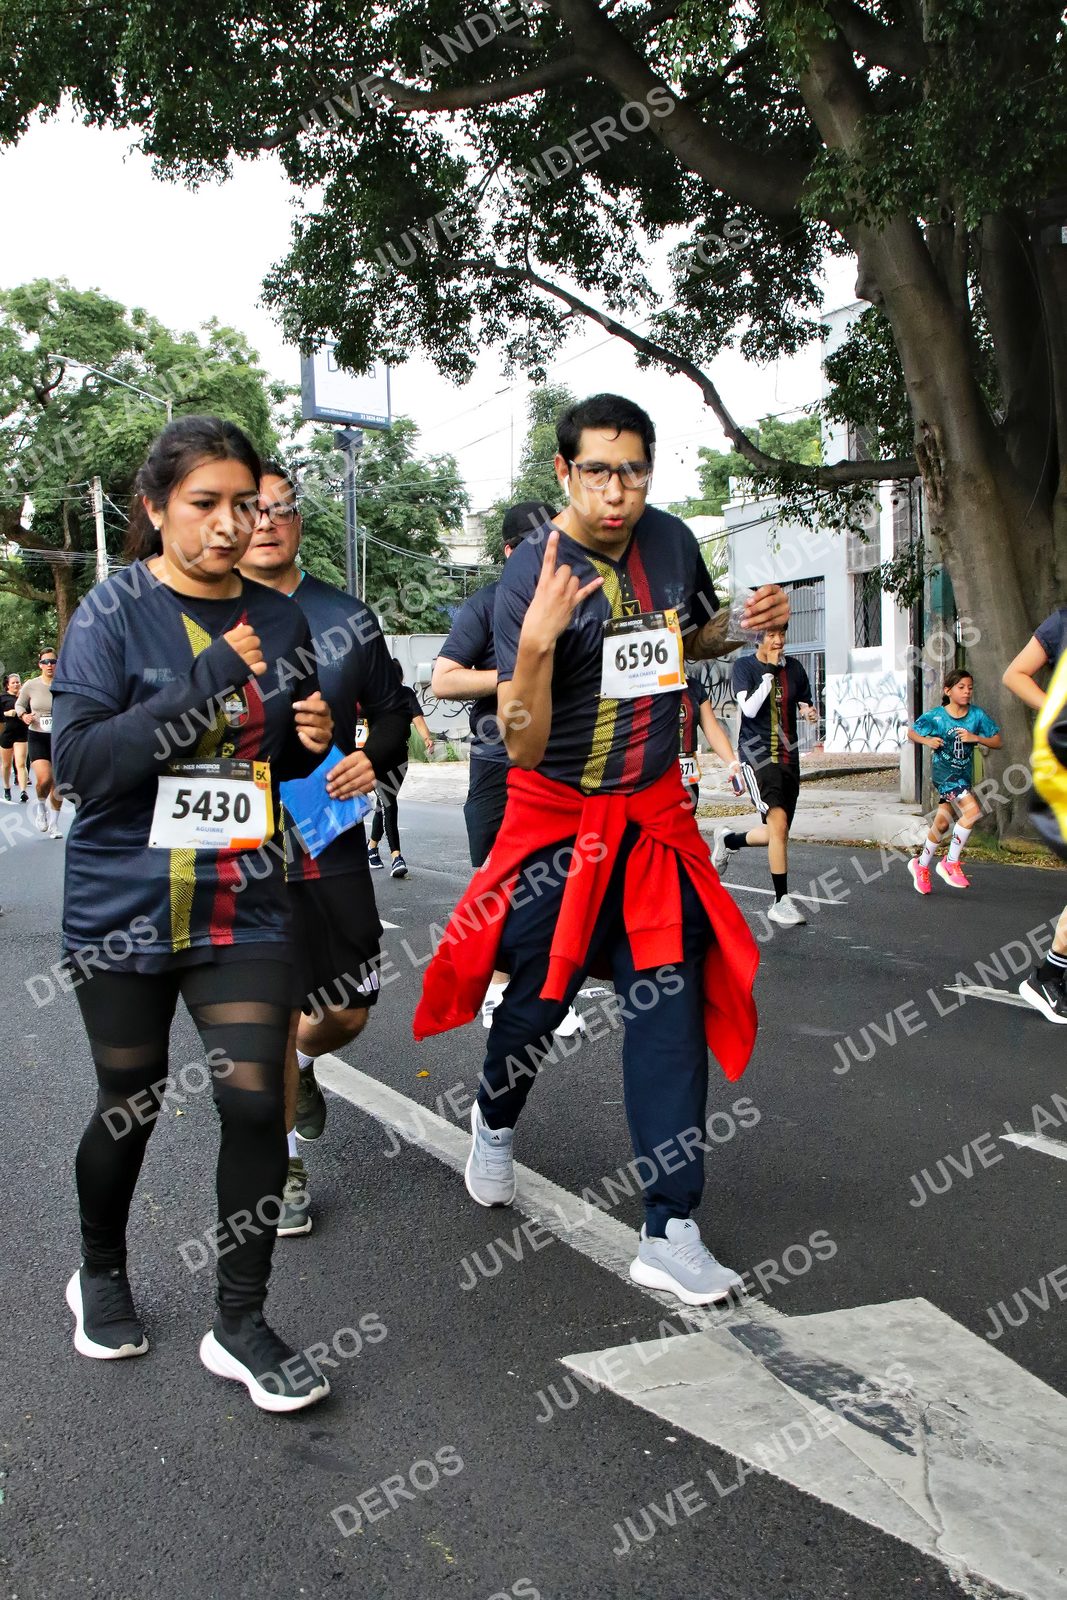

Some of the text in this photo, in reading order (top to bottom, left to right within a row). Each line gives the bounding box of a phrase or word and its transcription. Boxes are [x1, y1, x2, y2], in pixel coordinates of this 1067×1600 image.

[615, 638, 668, 672] 6596
[255, 770, 267, 781] 5K
[171, 789, 251, 824] 5430
